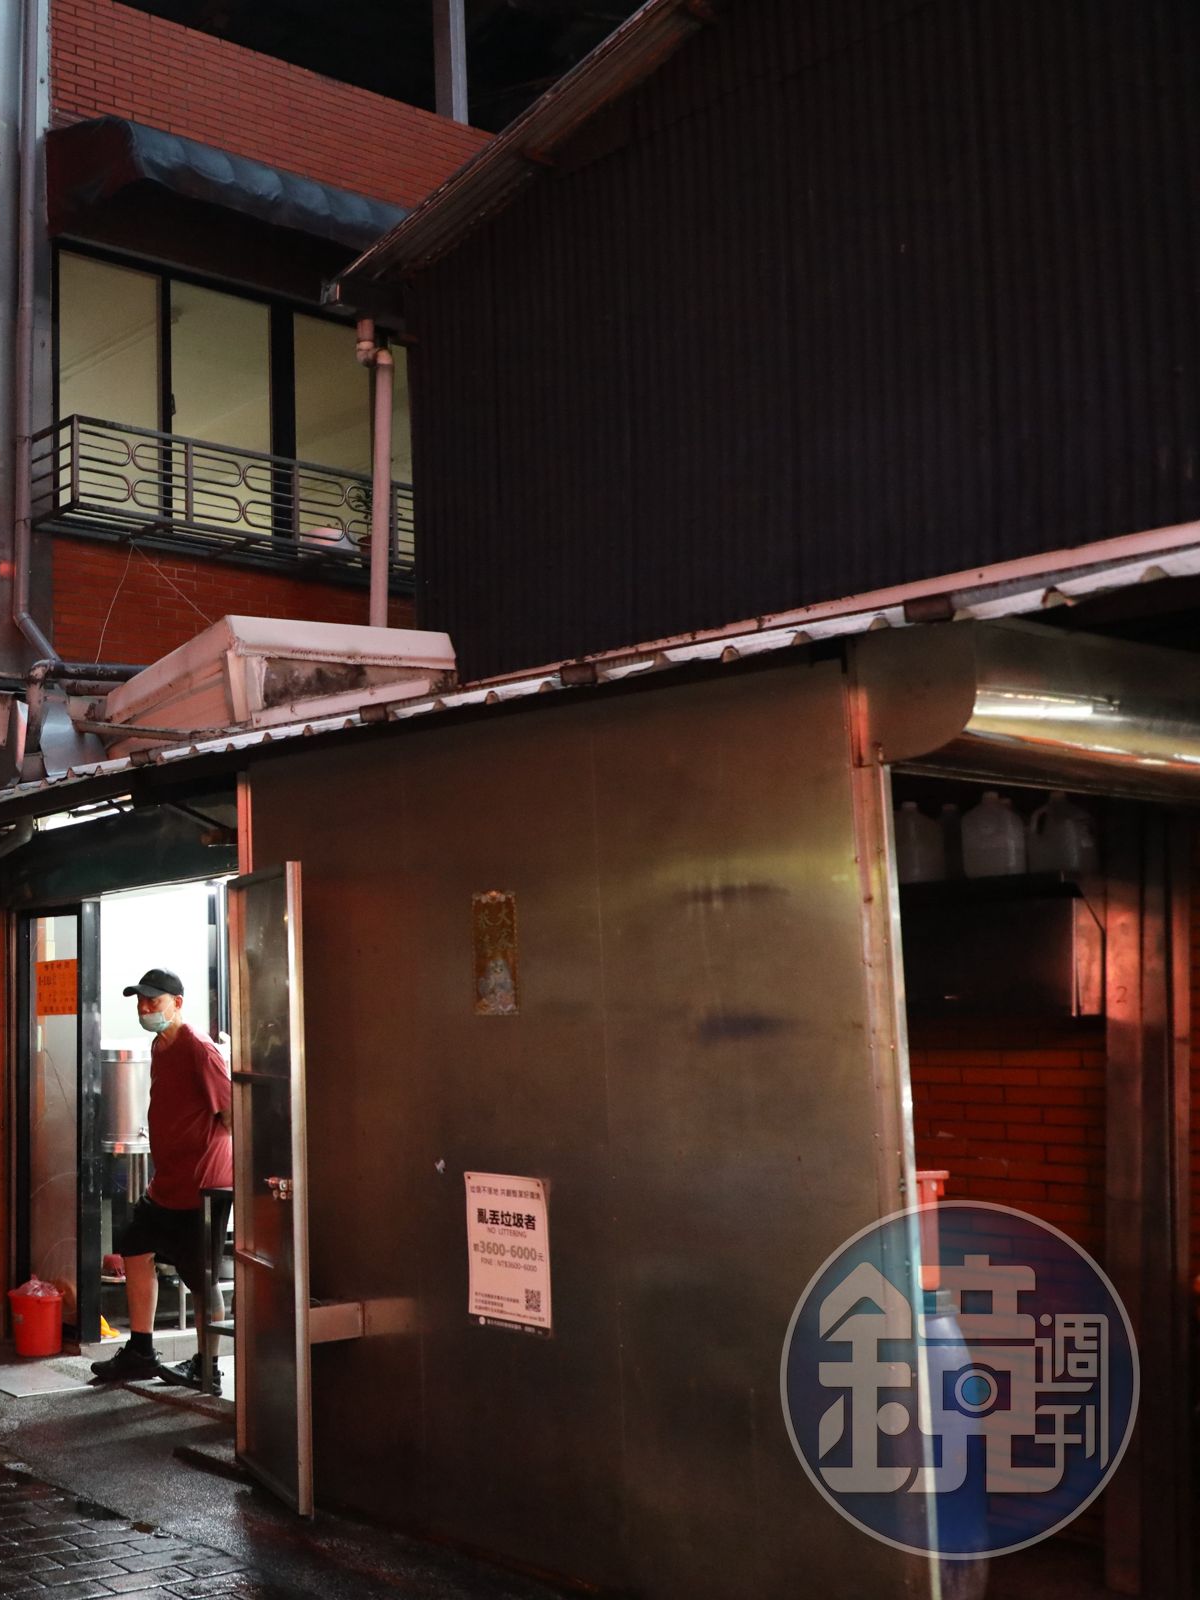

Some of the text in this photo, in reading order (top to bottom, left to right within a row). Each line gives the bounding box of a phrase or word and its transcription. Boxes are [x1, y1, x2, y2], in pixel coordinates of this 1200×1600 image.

[477, 1208, 537, 1231] 亂丟垃圾者
[498, 1228, 527, 1239] LITTERING
